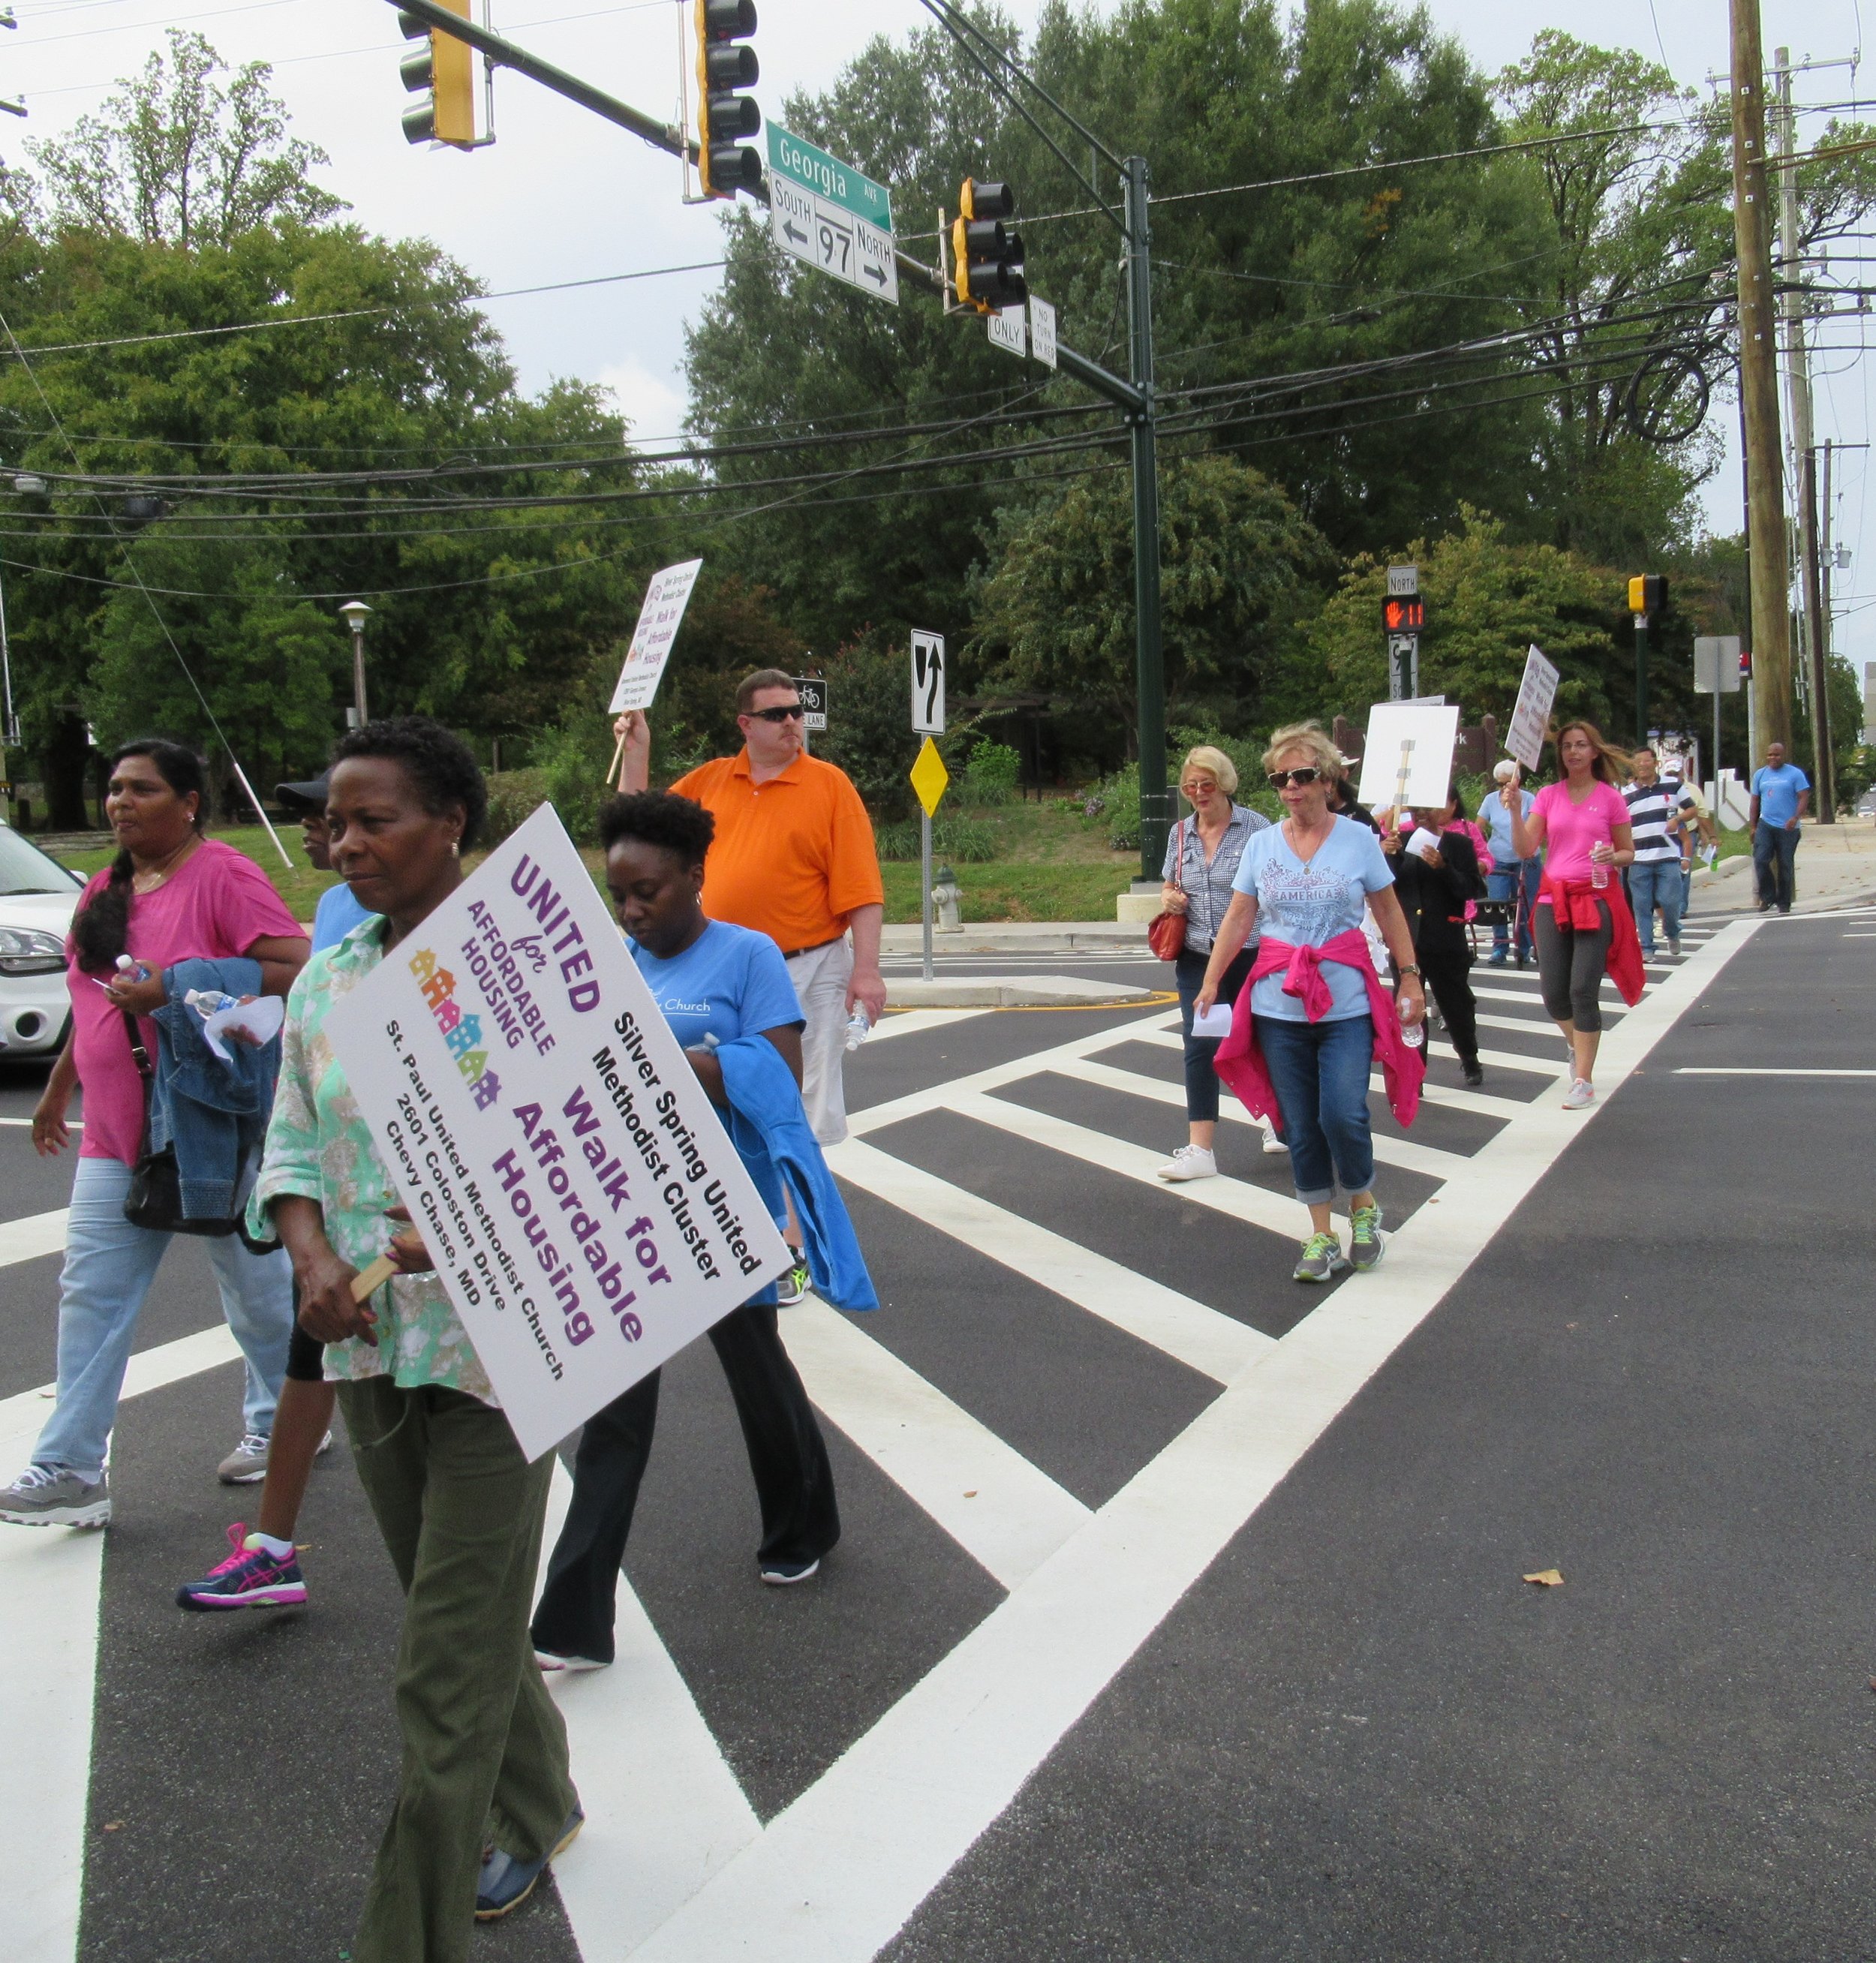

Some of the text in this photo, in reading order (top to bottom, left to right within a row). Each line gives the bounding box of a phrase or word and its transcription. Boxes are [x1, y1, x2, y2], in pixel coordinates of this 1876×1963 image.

[780, 138, 877, 203] Georgia AVE
[775, 179, 811, 224] SOUTH
[819, 225, 851, 273] 97
[857, 223, 891, 263] NORTH
[994, 317, 1020, 344] ONLY
[1037, 323, 1052, 341] TURN
[1039, 308, 1048, 323] NO
[1034, 338, 1055, 359] ON RED
[1390, 577, 1415, 592] NORTH
[1408, 603, 1424, 626] 11
[808, 714, 824, 726] LANE
[1280, 889, 1333, 900] AMERICA
[510, 935, 547, 974] for
[511, 853, 601, 1013] UNITED
[461, 936, 525, 1049] HOUSING
[467, 900, 556, 1057] AFFORDABLE
[665, 998, 711, 1012] Church
[591, 1045, 721, 1281] Methodist Cluster
[614, 1012, 762, 1276] Silver Spring United
[386, 1019, 564, 1382] St. Paul United Methodist Church
[396, 1093, 506, 1311] 2601 Coloston Drive
[562, 1085, 672, 1285] Walk for
[386, 1120, 481, 1306] Chevy Chase, MD
[512, 1102, 643, 1342] Affordable
[492, 1148, 595, 1346] Housing
